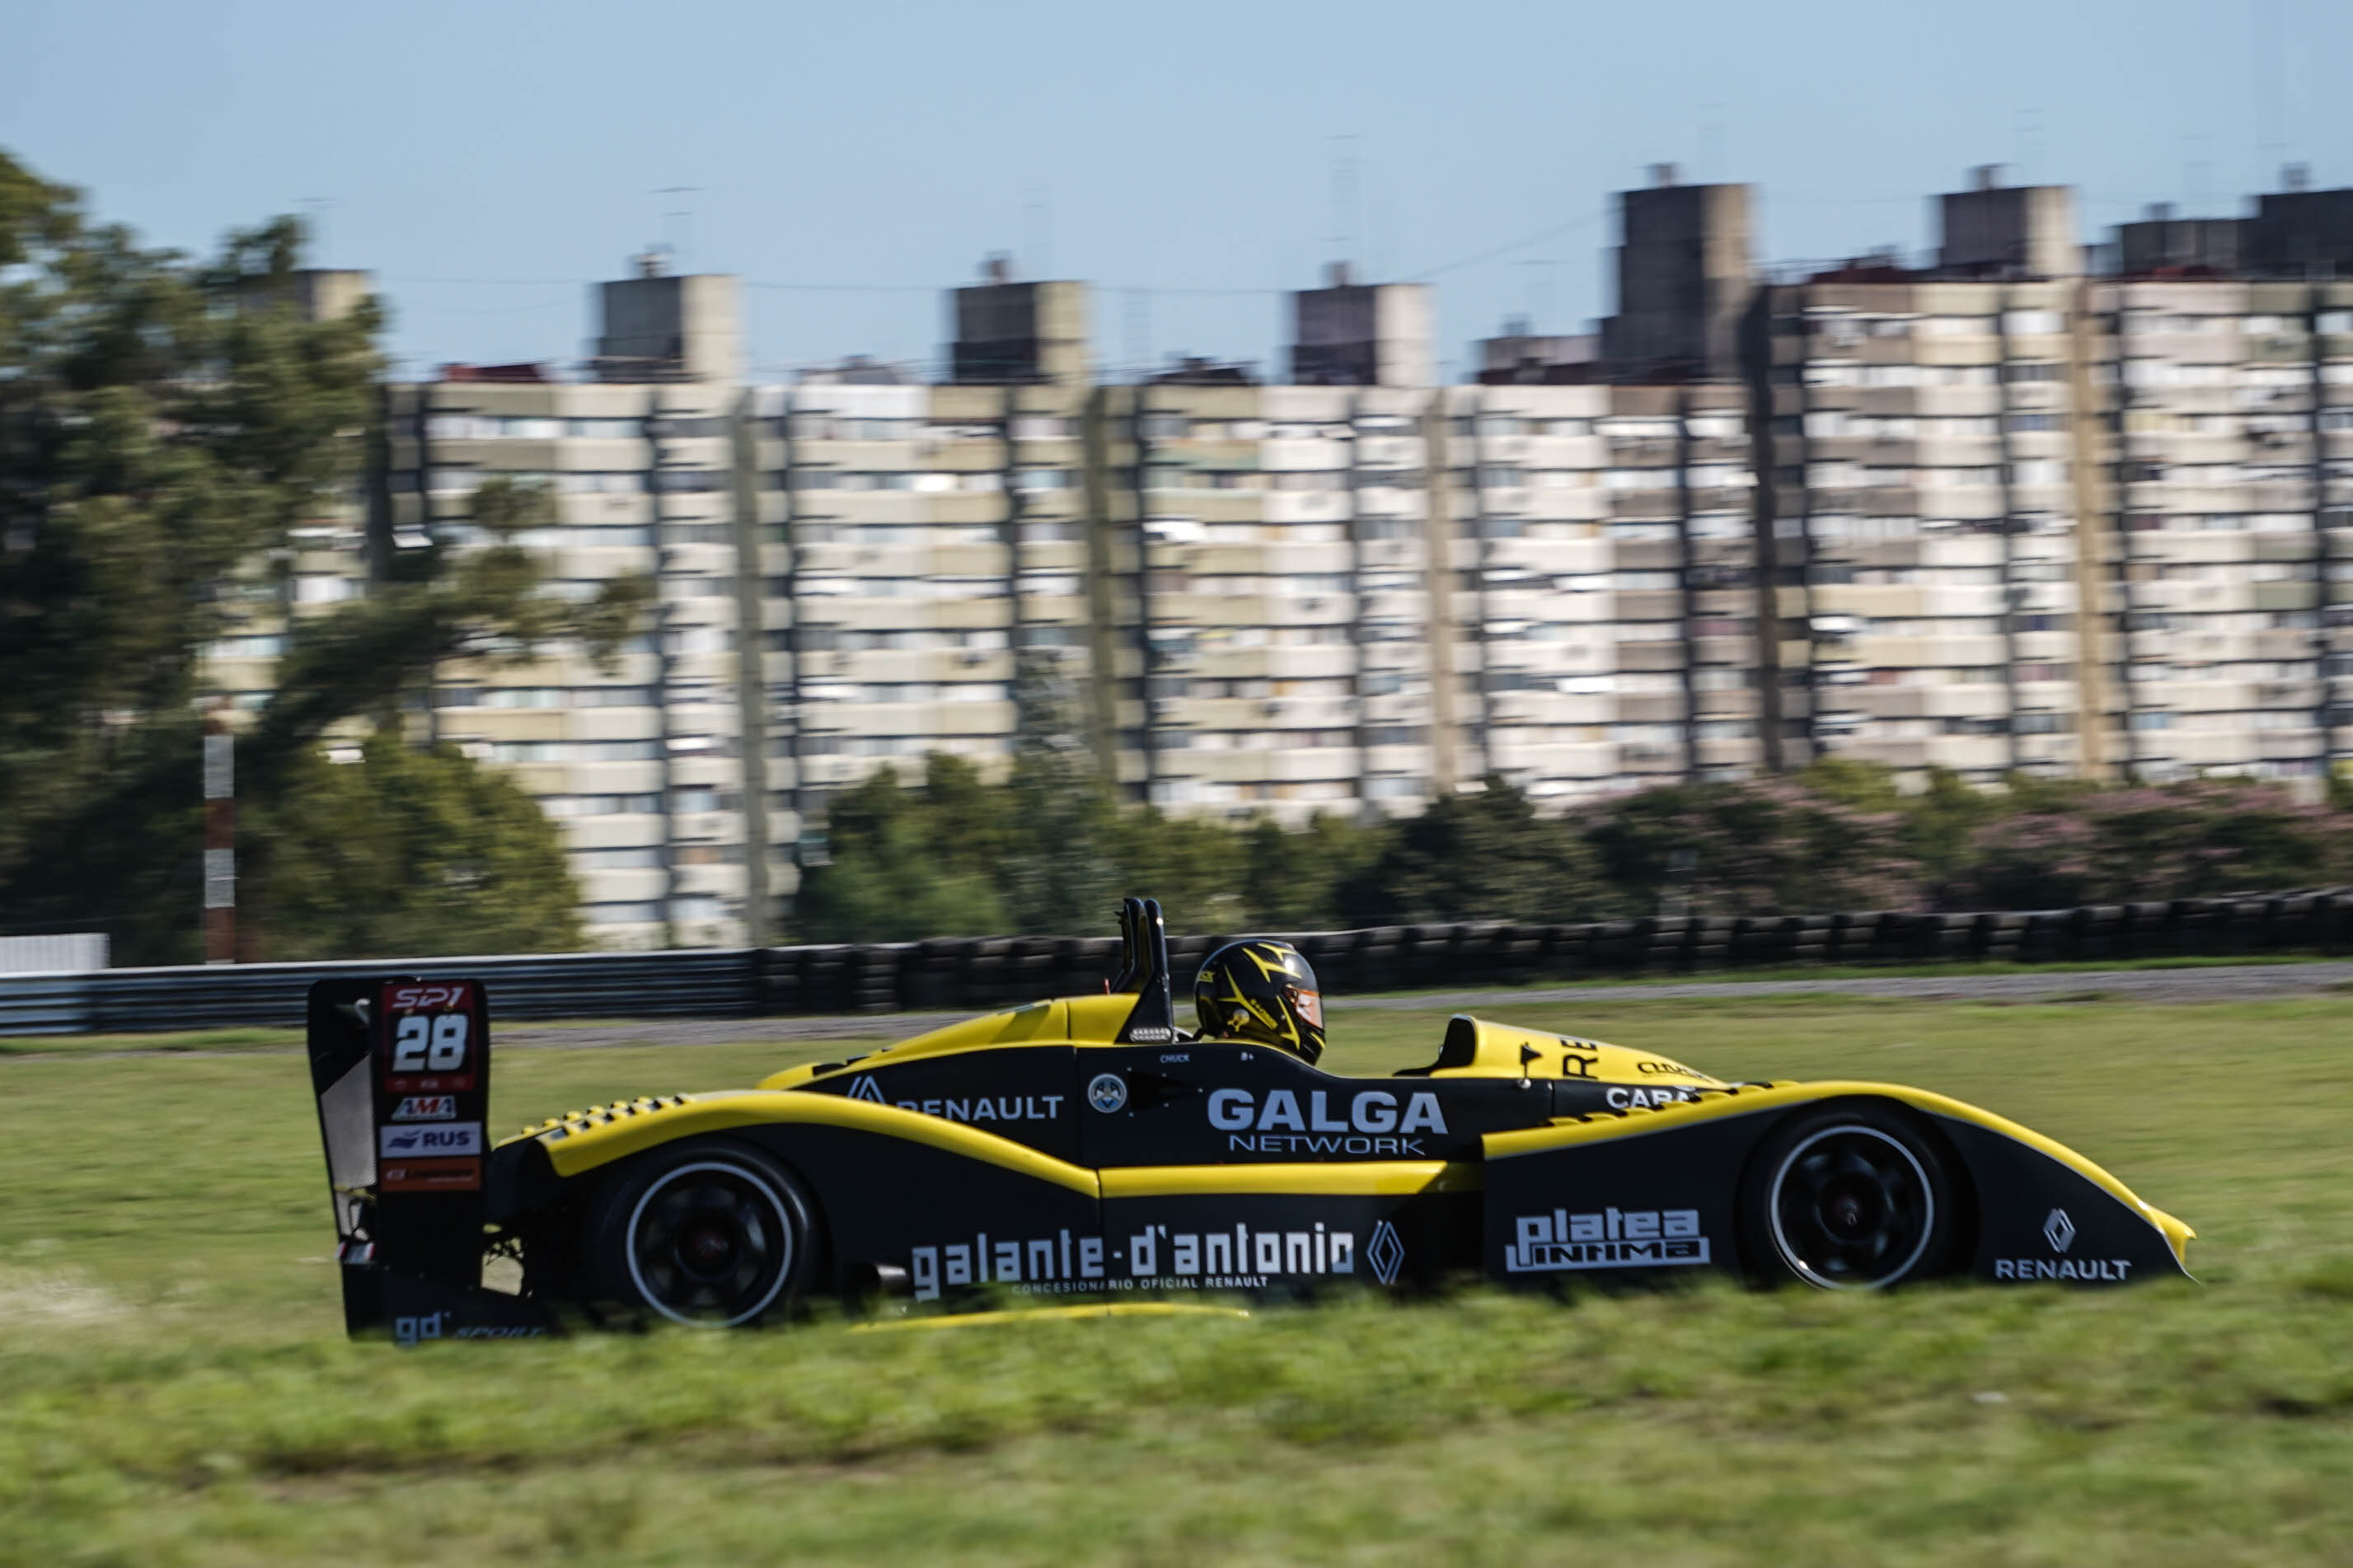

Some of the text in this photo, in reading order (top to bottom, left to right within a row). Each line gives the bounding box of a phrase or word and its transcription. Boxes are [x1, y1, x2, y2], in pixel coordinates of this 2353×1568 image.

[393, 1014, 468, 1071] 28
[1160, 1054, 1190, 1064] CHUCK
[1207, 1088, 1448, 1135] GALGA
[422, 1130, 471, 1148] RUS
[1229, 1135, 1425, 1155] NETWORK
[1516, 1206, 1699, 1267] platea
[912, 1229, 1105, 1301] galante
[1994, 1258, 2133, 1280] RENAULT
[1140, 1278, 1199, 1290] OFICIAL
[1205, 1275, 1268, 1289] RENAULT
